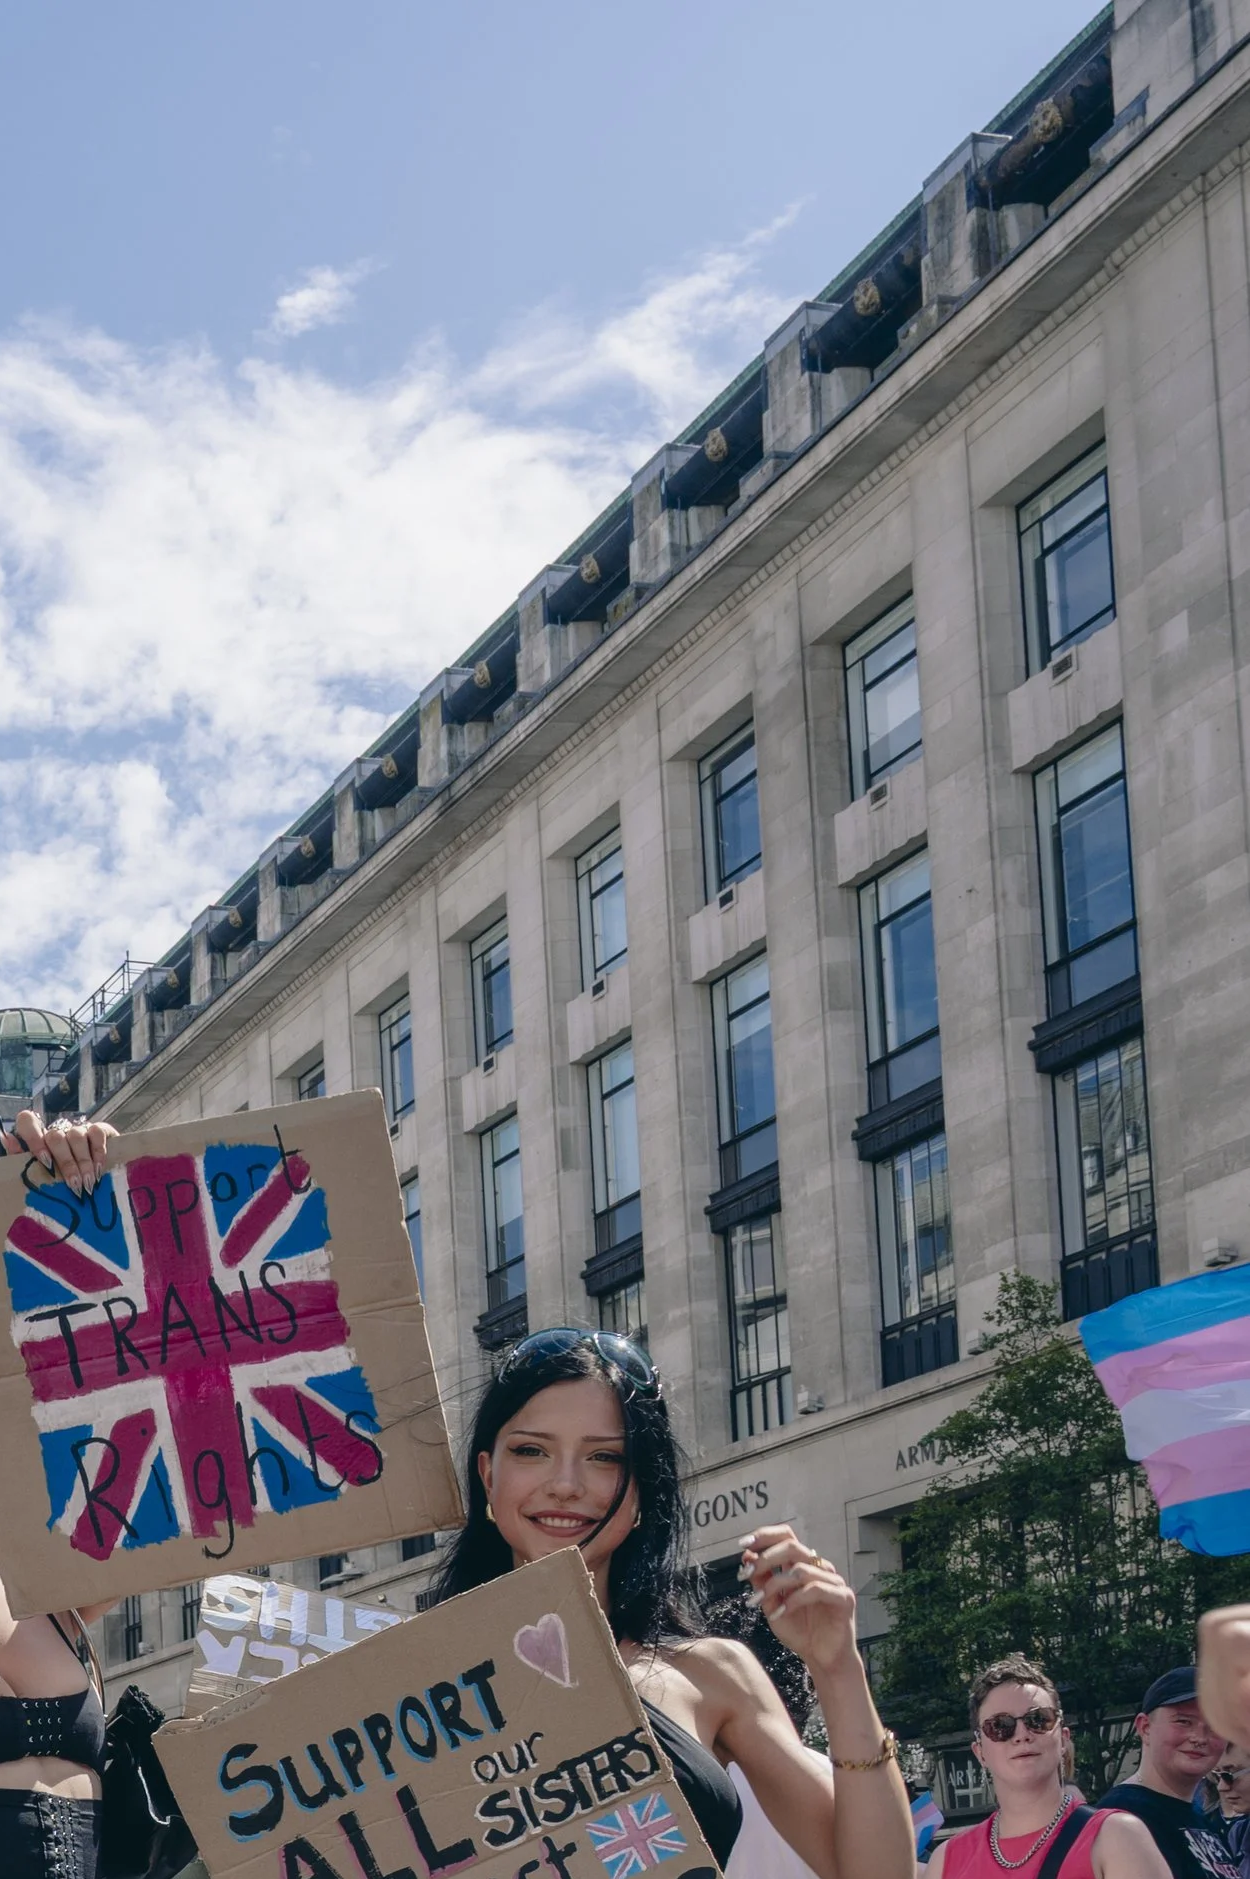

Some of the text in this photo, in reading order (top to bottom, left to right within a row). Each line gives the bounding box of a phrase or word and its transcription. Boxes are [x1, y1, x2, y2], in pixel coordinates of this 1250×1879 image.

[21, 1124, 311, 1255] Support
[25, 1262, 300, 1389] TRANS
[70, 1395, 383, 1560] Rights
[218, 1659, 508, 1842] SUPPORT
[472, 1732, 544, 1783] our
[474, 1727, 661, 1851] SISTERS
